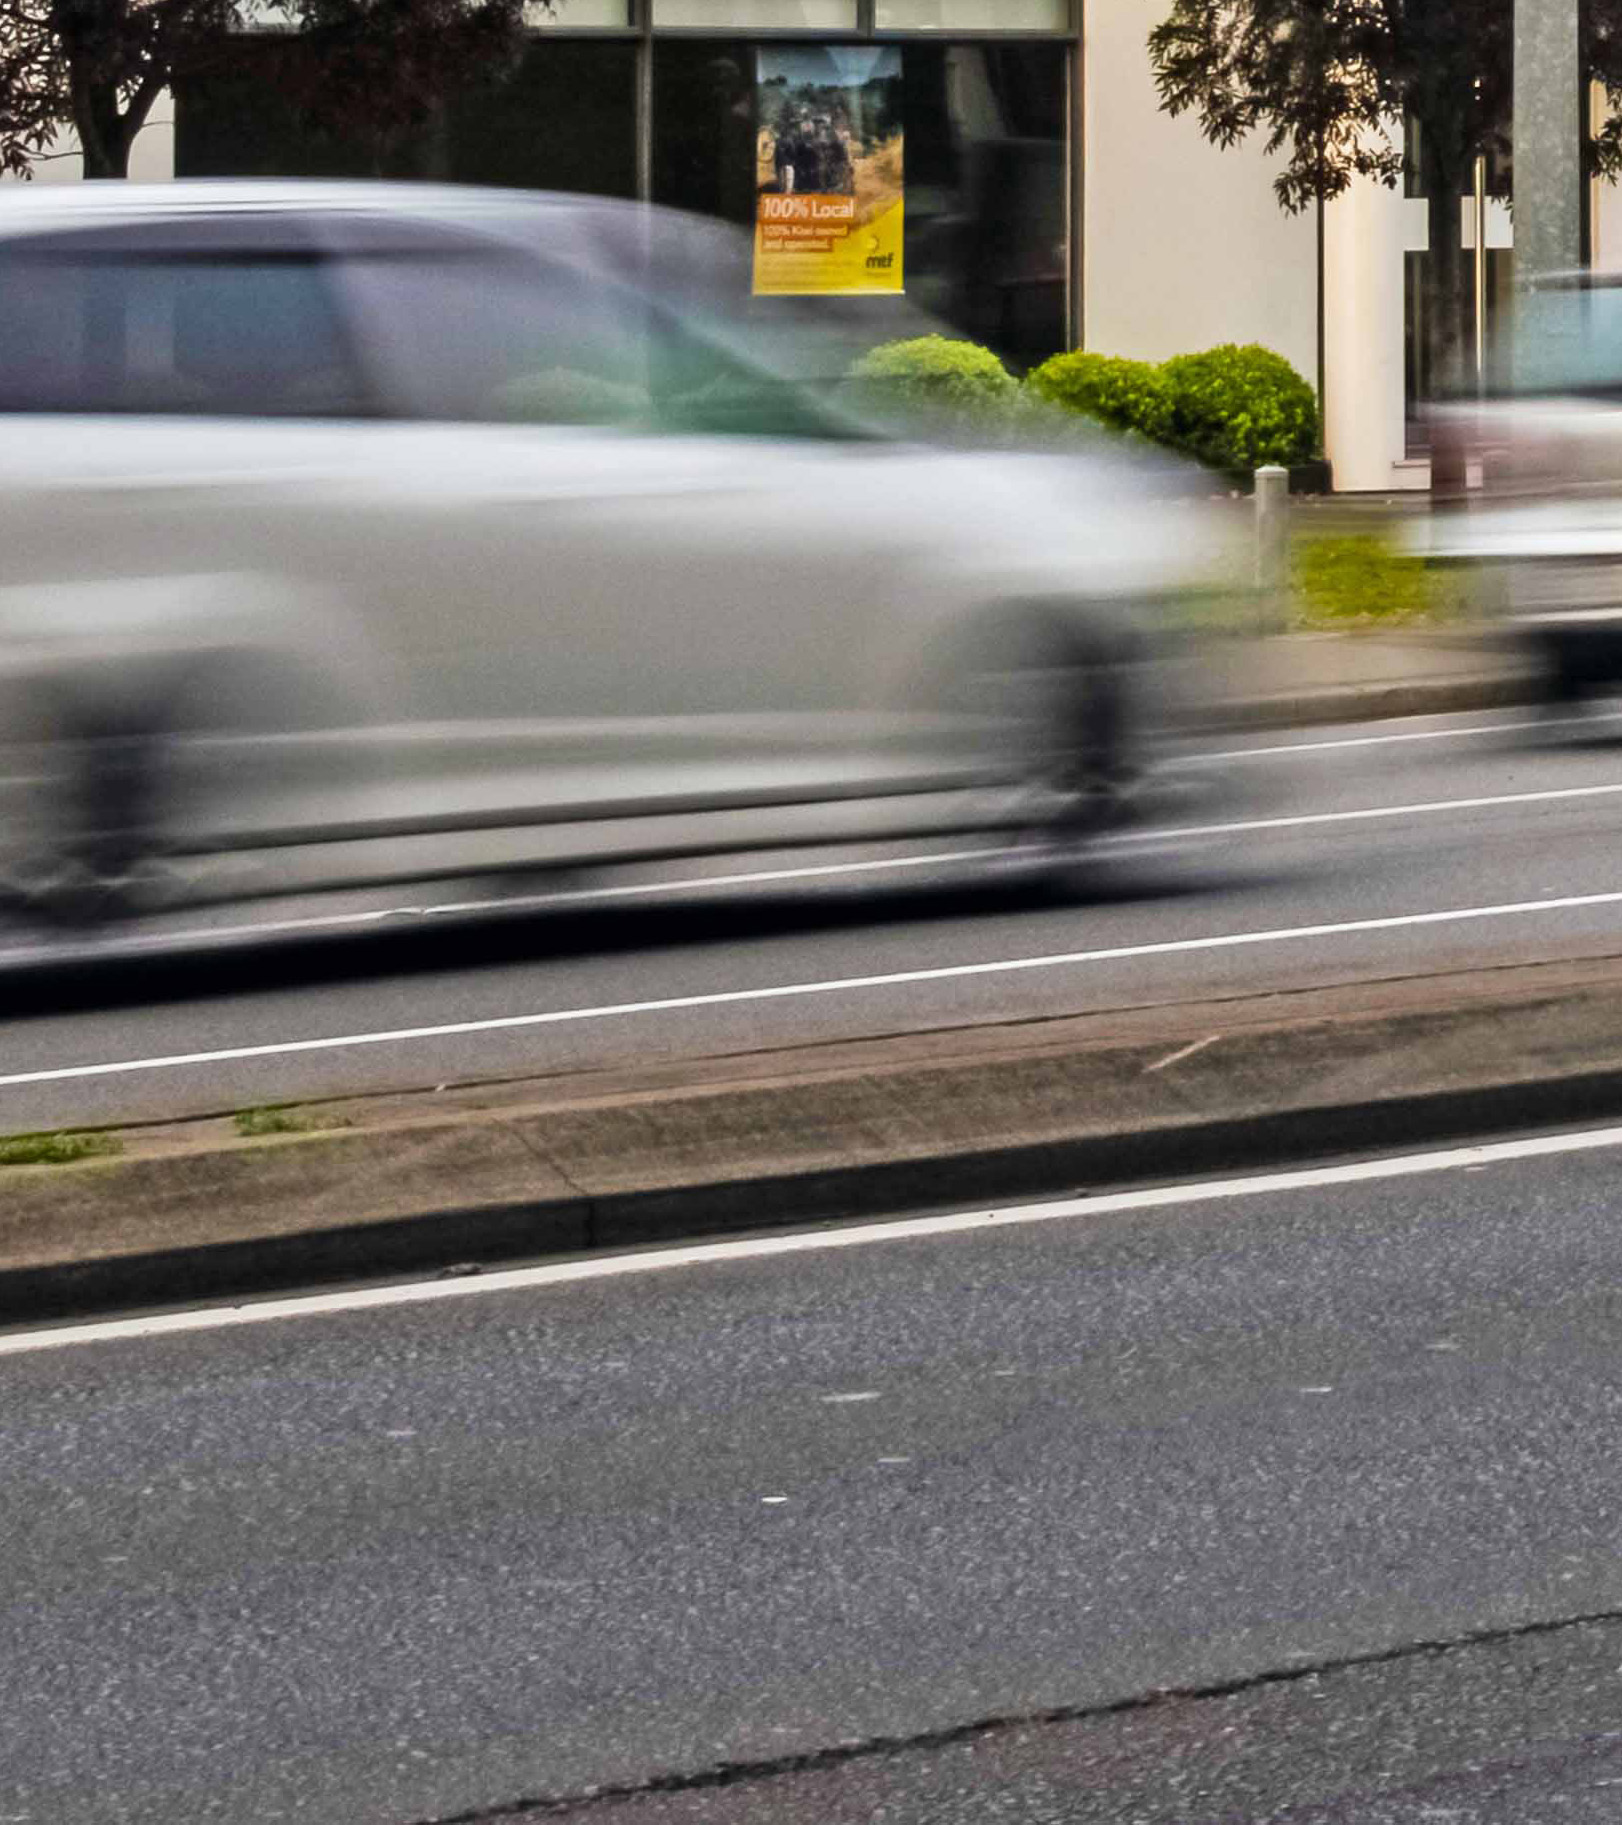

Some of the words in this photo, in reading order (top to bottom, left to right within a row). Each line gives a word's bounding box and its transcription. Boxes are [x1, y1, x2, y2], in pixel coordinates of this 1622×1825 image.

[763, 197, 809, 218] 100%
[811, 198, 854, 218] Local
[865, 252, 894, 268] mtf
